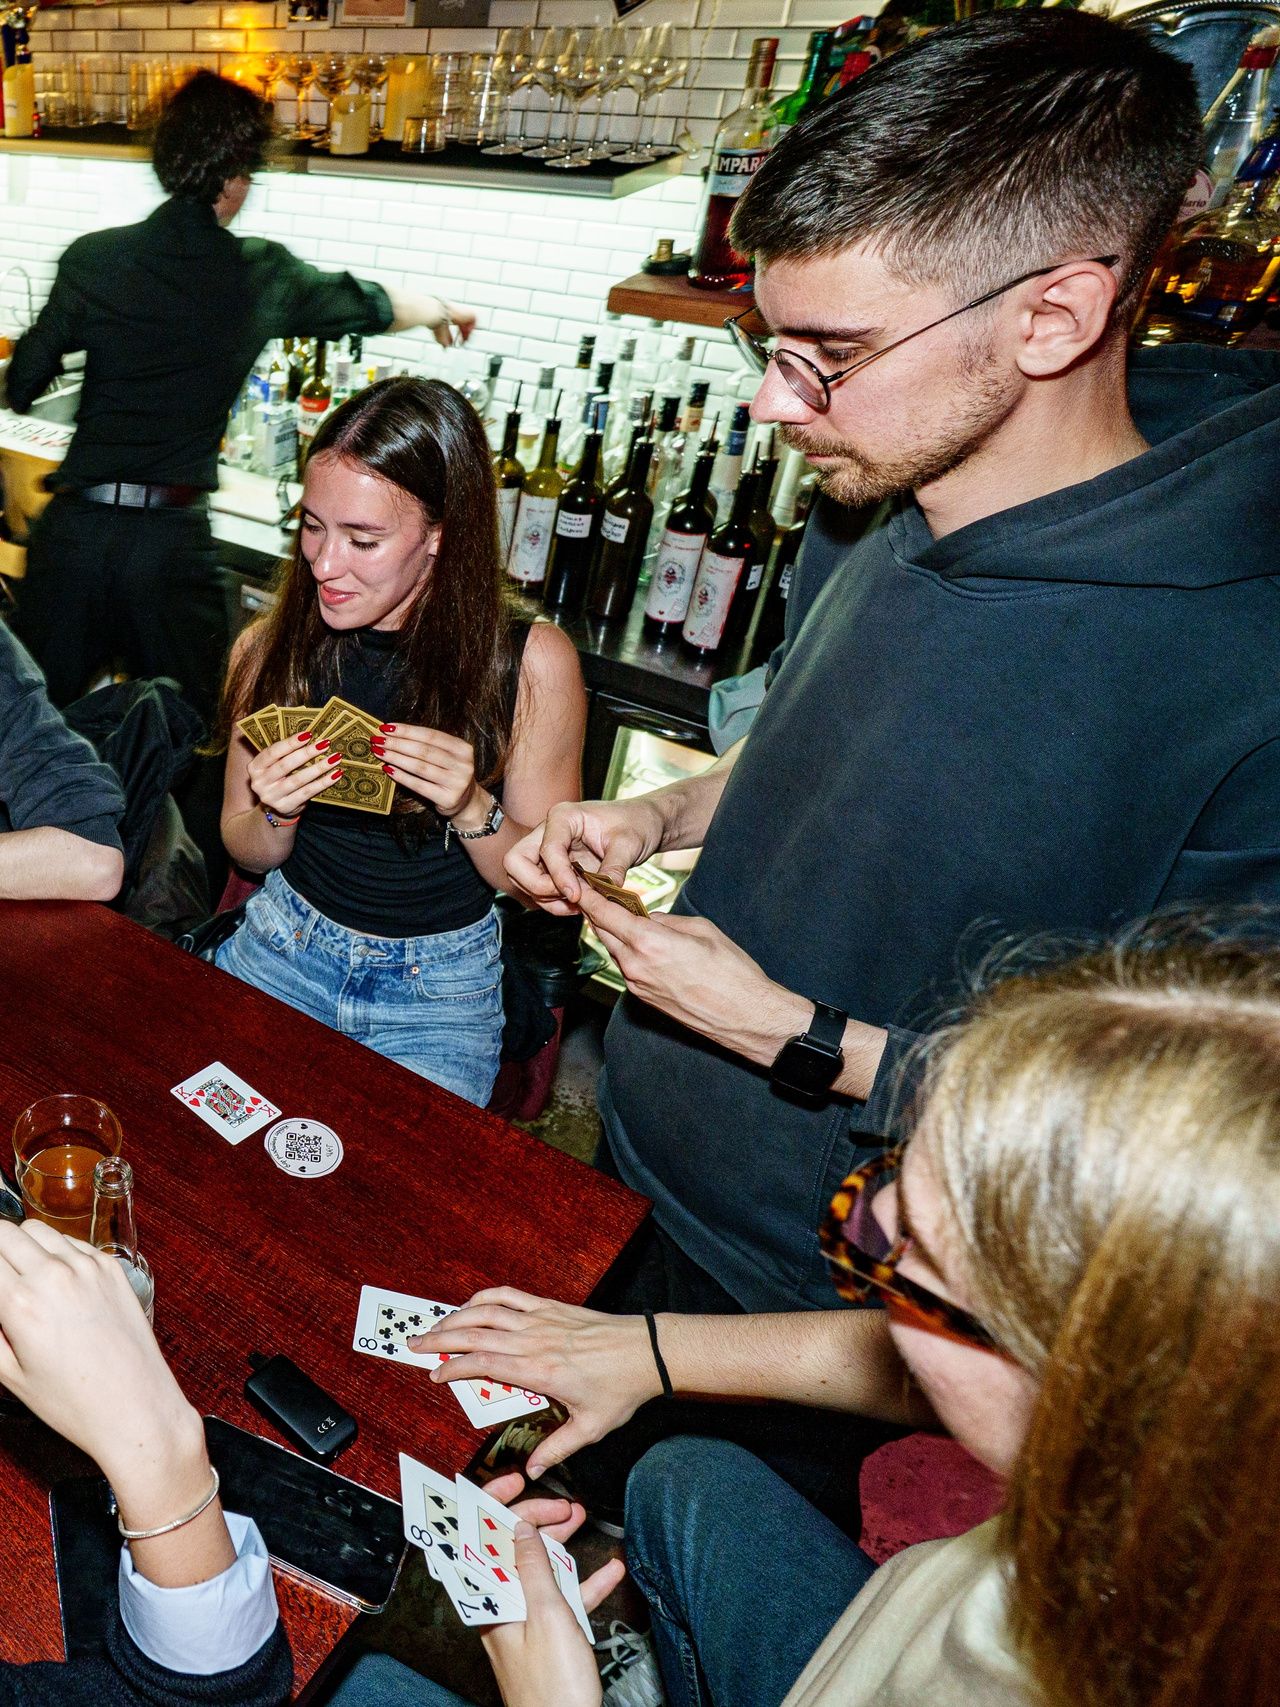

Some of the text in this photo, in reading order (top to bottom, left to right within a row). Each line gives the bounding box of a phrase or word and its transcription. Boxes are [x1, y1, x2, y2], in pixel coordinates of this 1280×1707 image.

[174, 1086, 192, 1100] K
[259, 1104, 278, 1119] K
[358, 1337, 378, 1351] 8
[523, 1388, 541, 1406] 8
[410, 1524, 433, 1548] 8
[464, 1543, 486, 1566] 7
[552, 1550, 573, 1573] 7
[457, 1599, 480, 1619] 7
